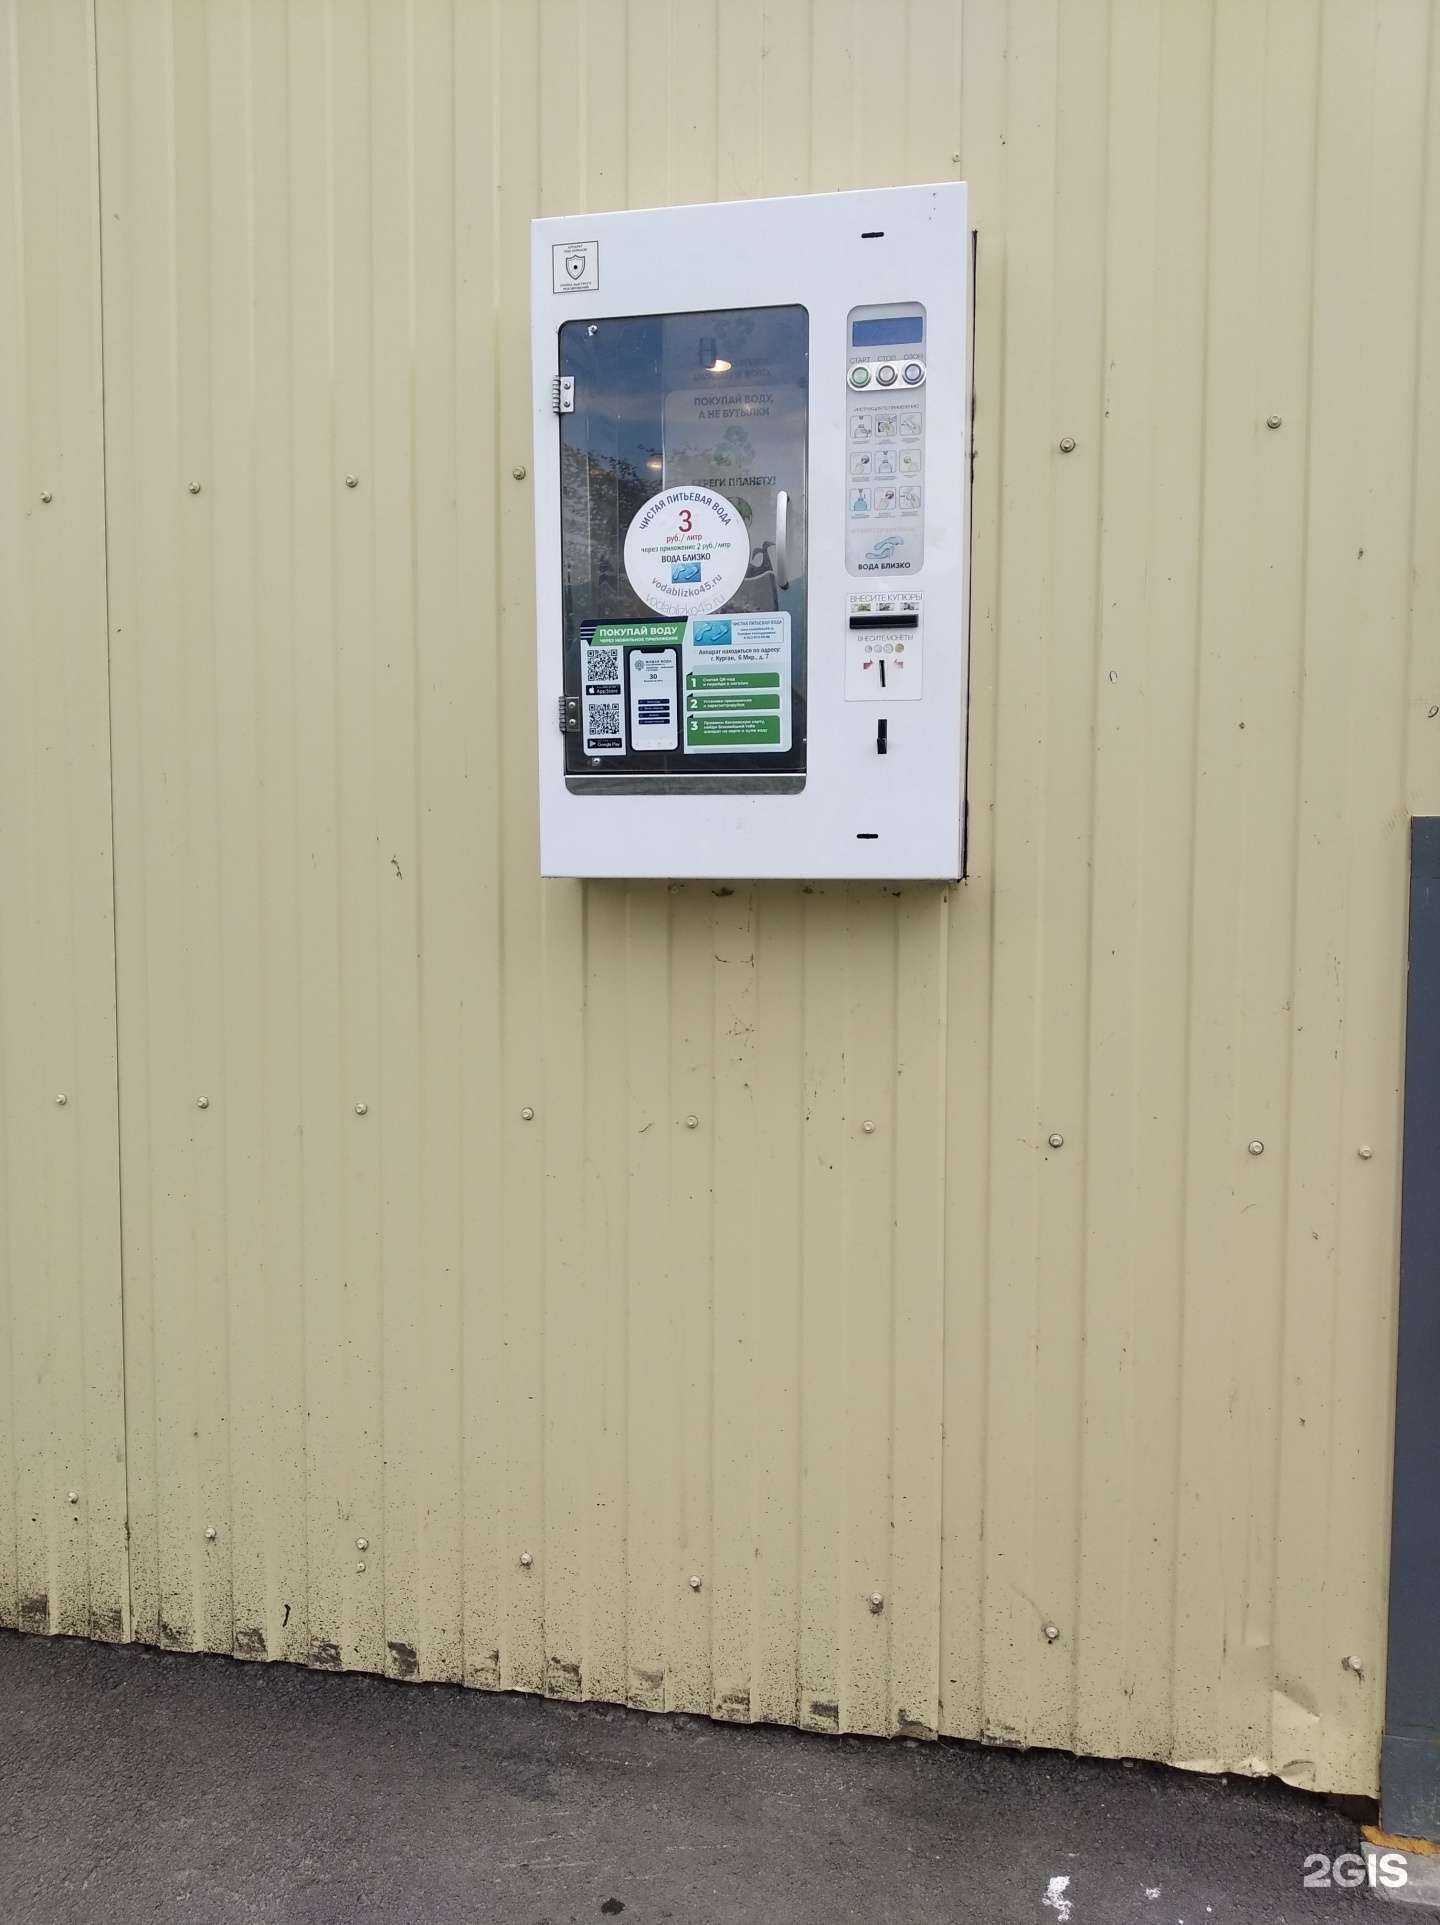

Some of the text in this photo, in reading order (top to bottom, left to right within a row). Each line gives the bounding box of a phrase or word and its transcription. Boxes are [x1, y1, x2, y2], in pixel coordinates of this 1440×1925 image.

[639, 492, 732, 531] ЧИСТАЯ ПИТЬЕВАЯ ВОДА
[678, 509, 692, 533] 3
[661, 552, 711, 564] ВОДА БЛИЗКО
[881, 562, 911, 570] БЛИЗКО
[652, 573, 723, 598] vodablizko45.ru
[850, 592, 922, 603] ВНЕСИТЕ КУПЮРЫ
[600, 626, 678, 638] ПОКУПАЙ ВОДУ
[691, 678, 696, 688] 1
[690, 699, 698, 709] 2
[690, 720, 698, 730] 3
